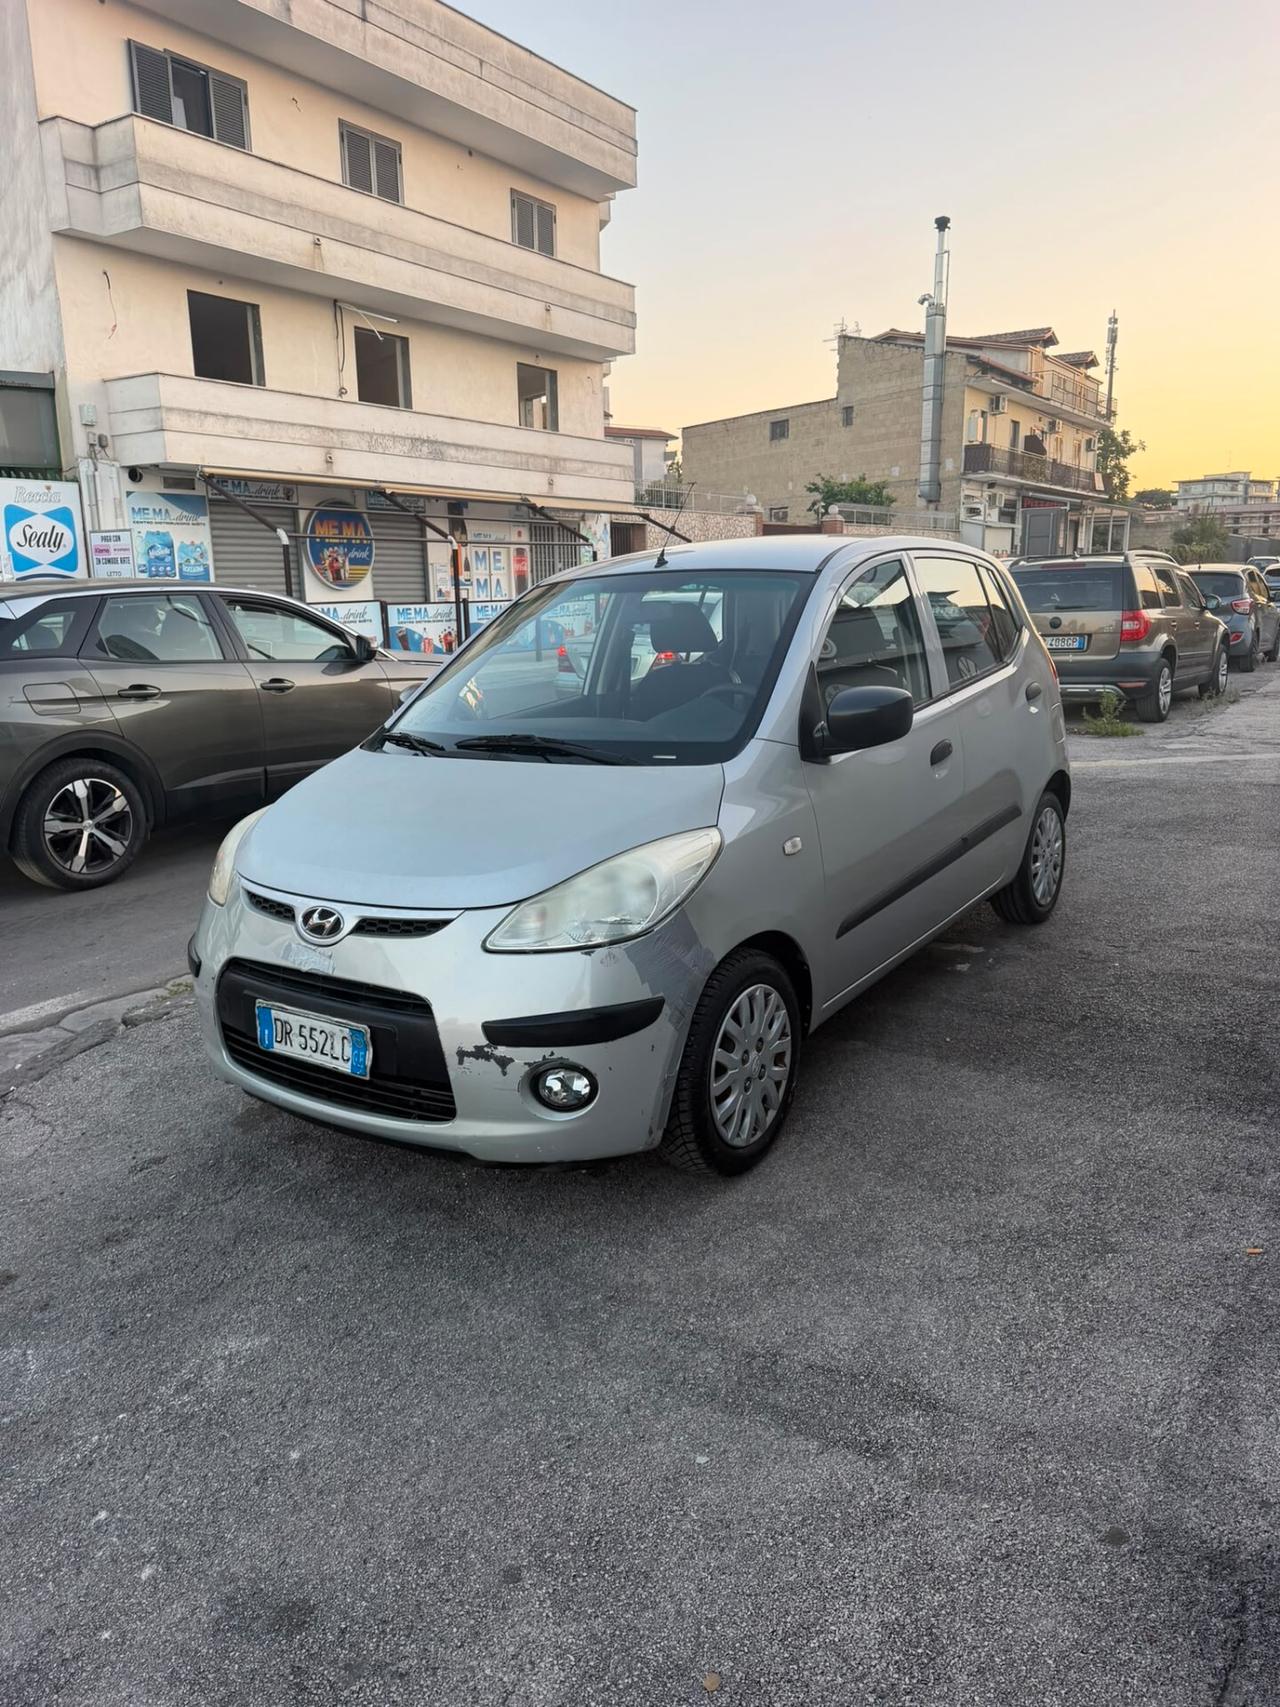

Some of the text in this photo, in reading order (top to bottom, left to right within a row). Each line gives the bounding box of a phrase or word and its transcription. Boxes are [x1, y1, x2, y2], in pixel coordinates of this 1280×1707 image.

[16, 524, 64, 553] Sealy
[344, 606, 368, 620] drink
[274, 1018, 293, 1048] DR
